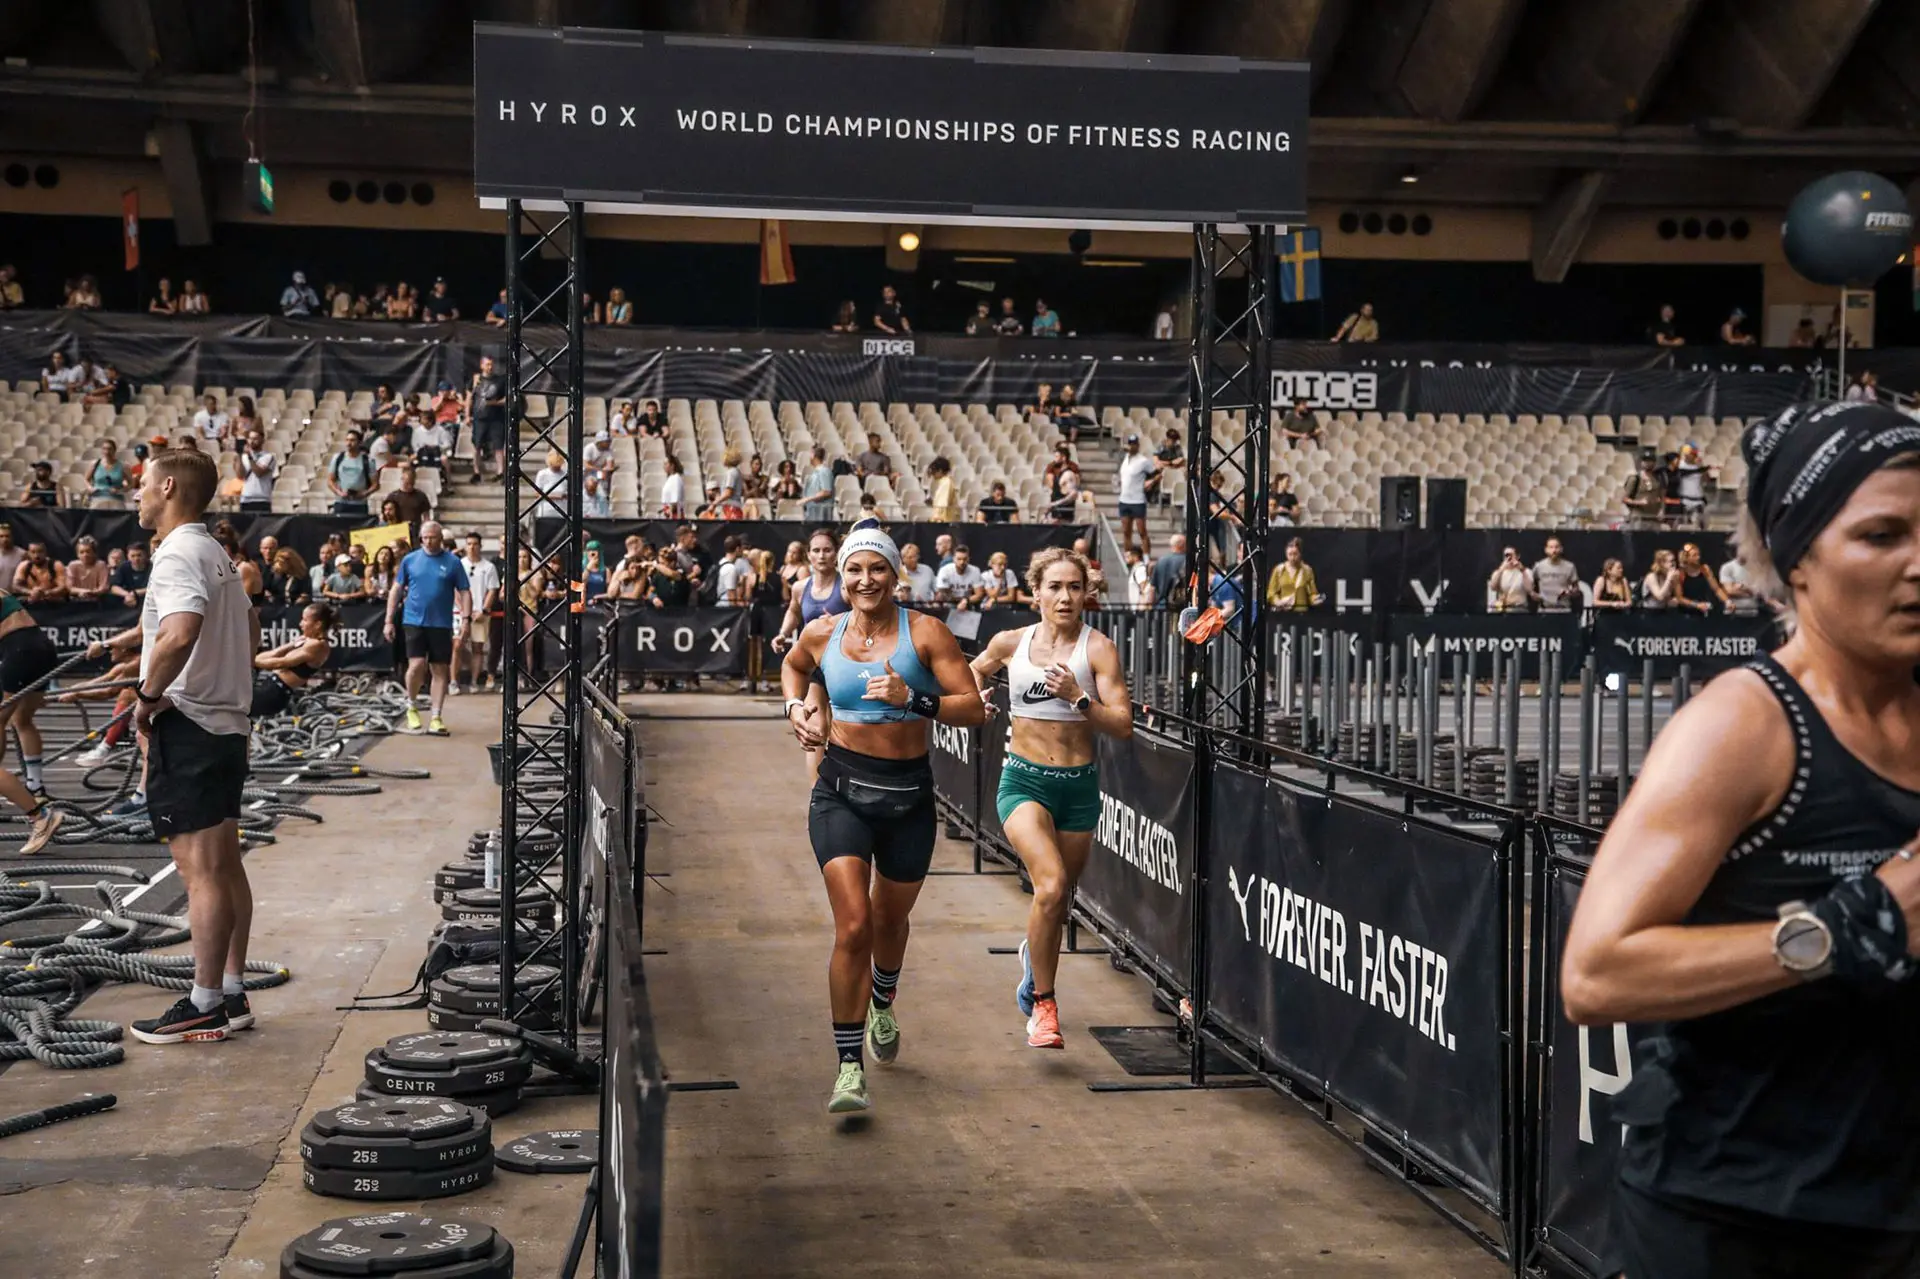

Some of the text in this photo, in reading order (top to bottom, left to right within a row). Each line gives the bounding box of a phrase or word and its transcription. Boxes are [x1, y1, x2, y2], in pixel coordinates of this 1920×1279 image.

[500, 100, 1291, 152] HYROX WORLD CHAMPIONSHIPS OF FITNESS RACING
[1271, 370, 1377, 408] NICE
[848, 541, 883, 551] FINLAND
[1637, 636, 1703, 656] FOREVER.
[1097, 790, 1182, 896] FOREVER. FASTER.
[1800, 849, 1892, 867] INTERSPOR
[1259, 877, 1456, 1051] FOREVER. FASTER.
[386, 1078, 436, 1092] CENTR
[440, 1144, 477, 1160] HYROX
[441, 1172, 480, 1189] HYROX
